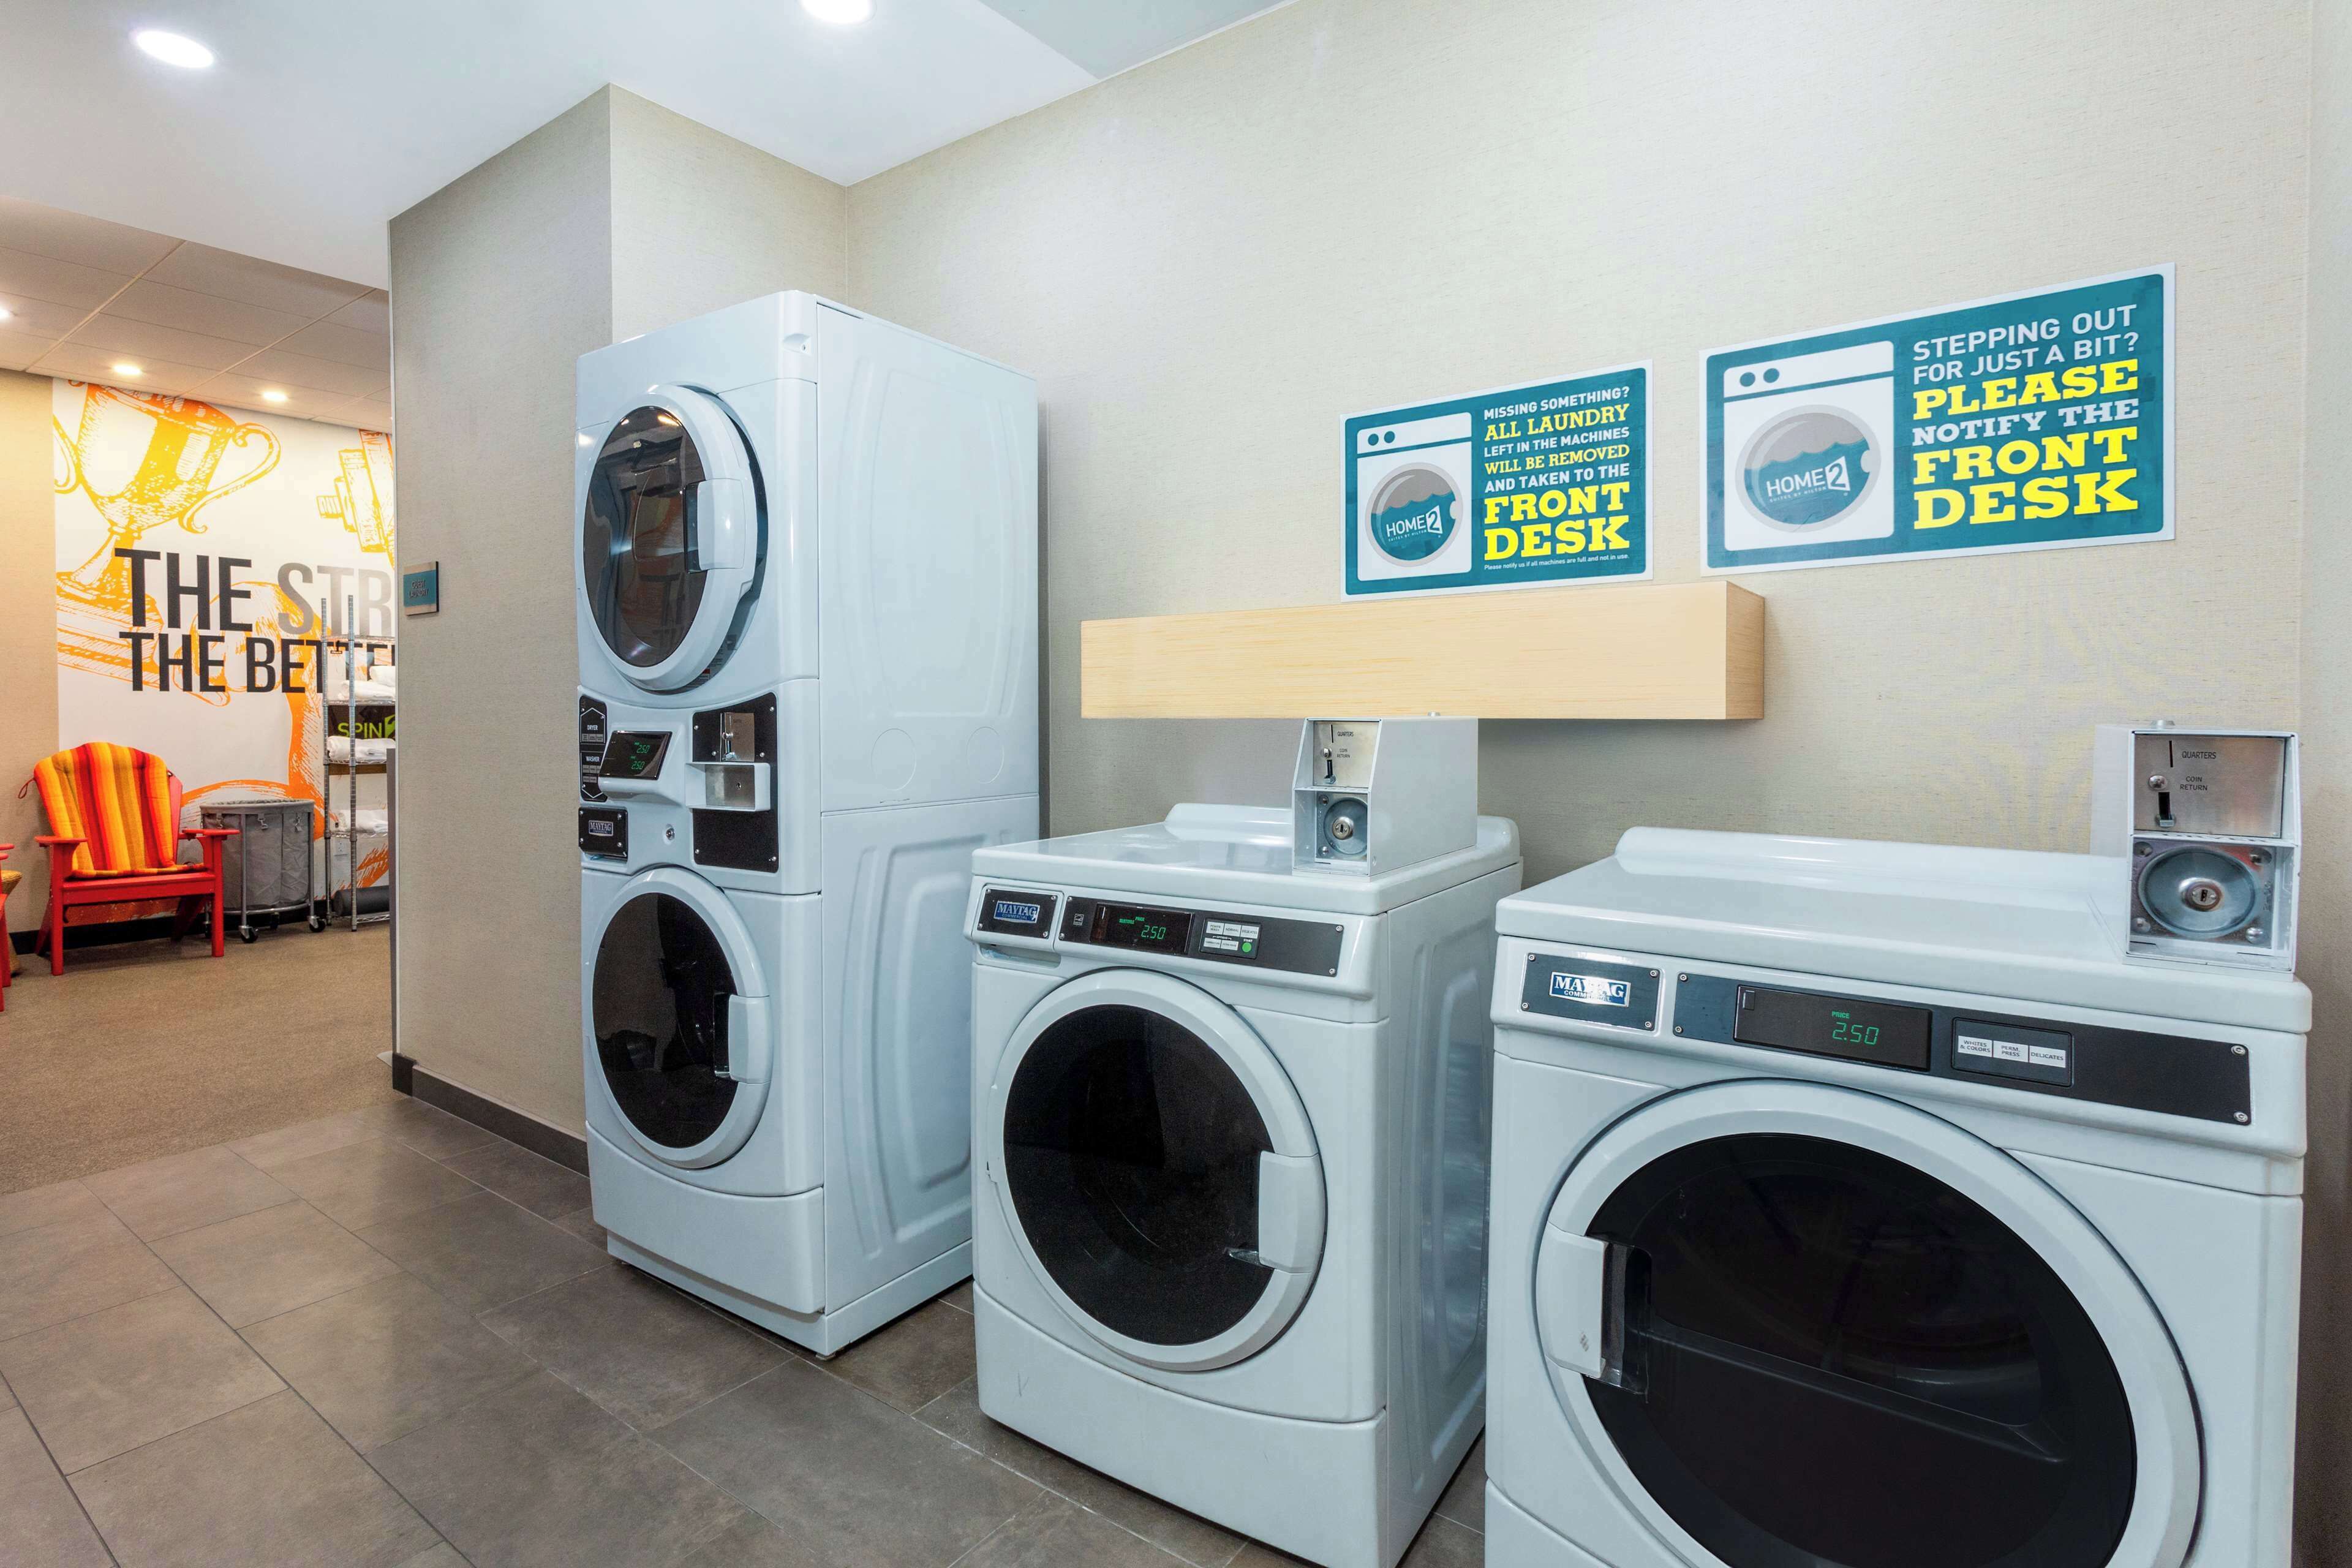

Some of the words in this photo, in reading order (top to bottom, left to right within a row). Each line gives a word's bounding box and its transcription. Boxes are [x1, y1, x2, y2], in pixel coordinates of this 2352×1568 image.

[1913, 318, 2060, 361] STEPPING
[2072, 304, 2136, 334] OUT
[1913, 360, 1963, 385] FOR
[1970, 347, 2038, 376] JUST
[2045, 345, 2065, 365] A
[2074, 332, 2139, 361] BIT?
[1484, 402, 1537, 420] MISSING
[1540, 386, 1629, 411] SOMETHING?
[1913, 358, 2138, 420] PLEASE
[1485, 421, 1521, 441] ALL
[1528, 404, 1630, 435] LAUNDRY
[1912, 411, 2046, 446] NOTIFY
[2058, 398, 2139, 427] THE
[1484, 443, 1514, 458] LEFT
[1517, 442, 1529, 453] IN
[1532, 437, 1558, 450] THE
[1561, 427, 1629, 447] MACHINES
[1485, 459, 1521, 475] WILL
[1526, 456, 1545, 470] BE
[1548, 444, 1630, 467] REMOVED
[1913, 426, 2138, 485] FRONT
[1485, 478, 1515, 493] AND
[1519, 470, 1569, 489] TAKEN
[1574, 467, 1594, 482] TO
[1598, 463, 1629, 478] THE
[1484, 481, 1630, 524] FRONT
[1914, 469, 2138, 529] DESK
[1484, 515, 1630, 560] DESK
[115, 548, 252, 631] THE
[119, 631, 225, 692] THE
[246, 636, 395, 693] BETTE
[590, 822, 611, 831] MAYTAG
[997, 903, 1036, 916] MAYTAG
[1141, 925, 1166, 940] 2.50
[1554, 976, 1624, 998] MAYAG
[1832, 1021, 1879, 1045] 2.50
[2030, 1052, 2064, 1061] DELICATES
